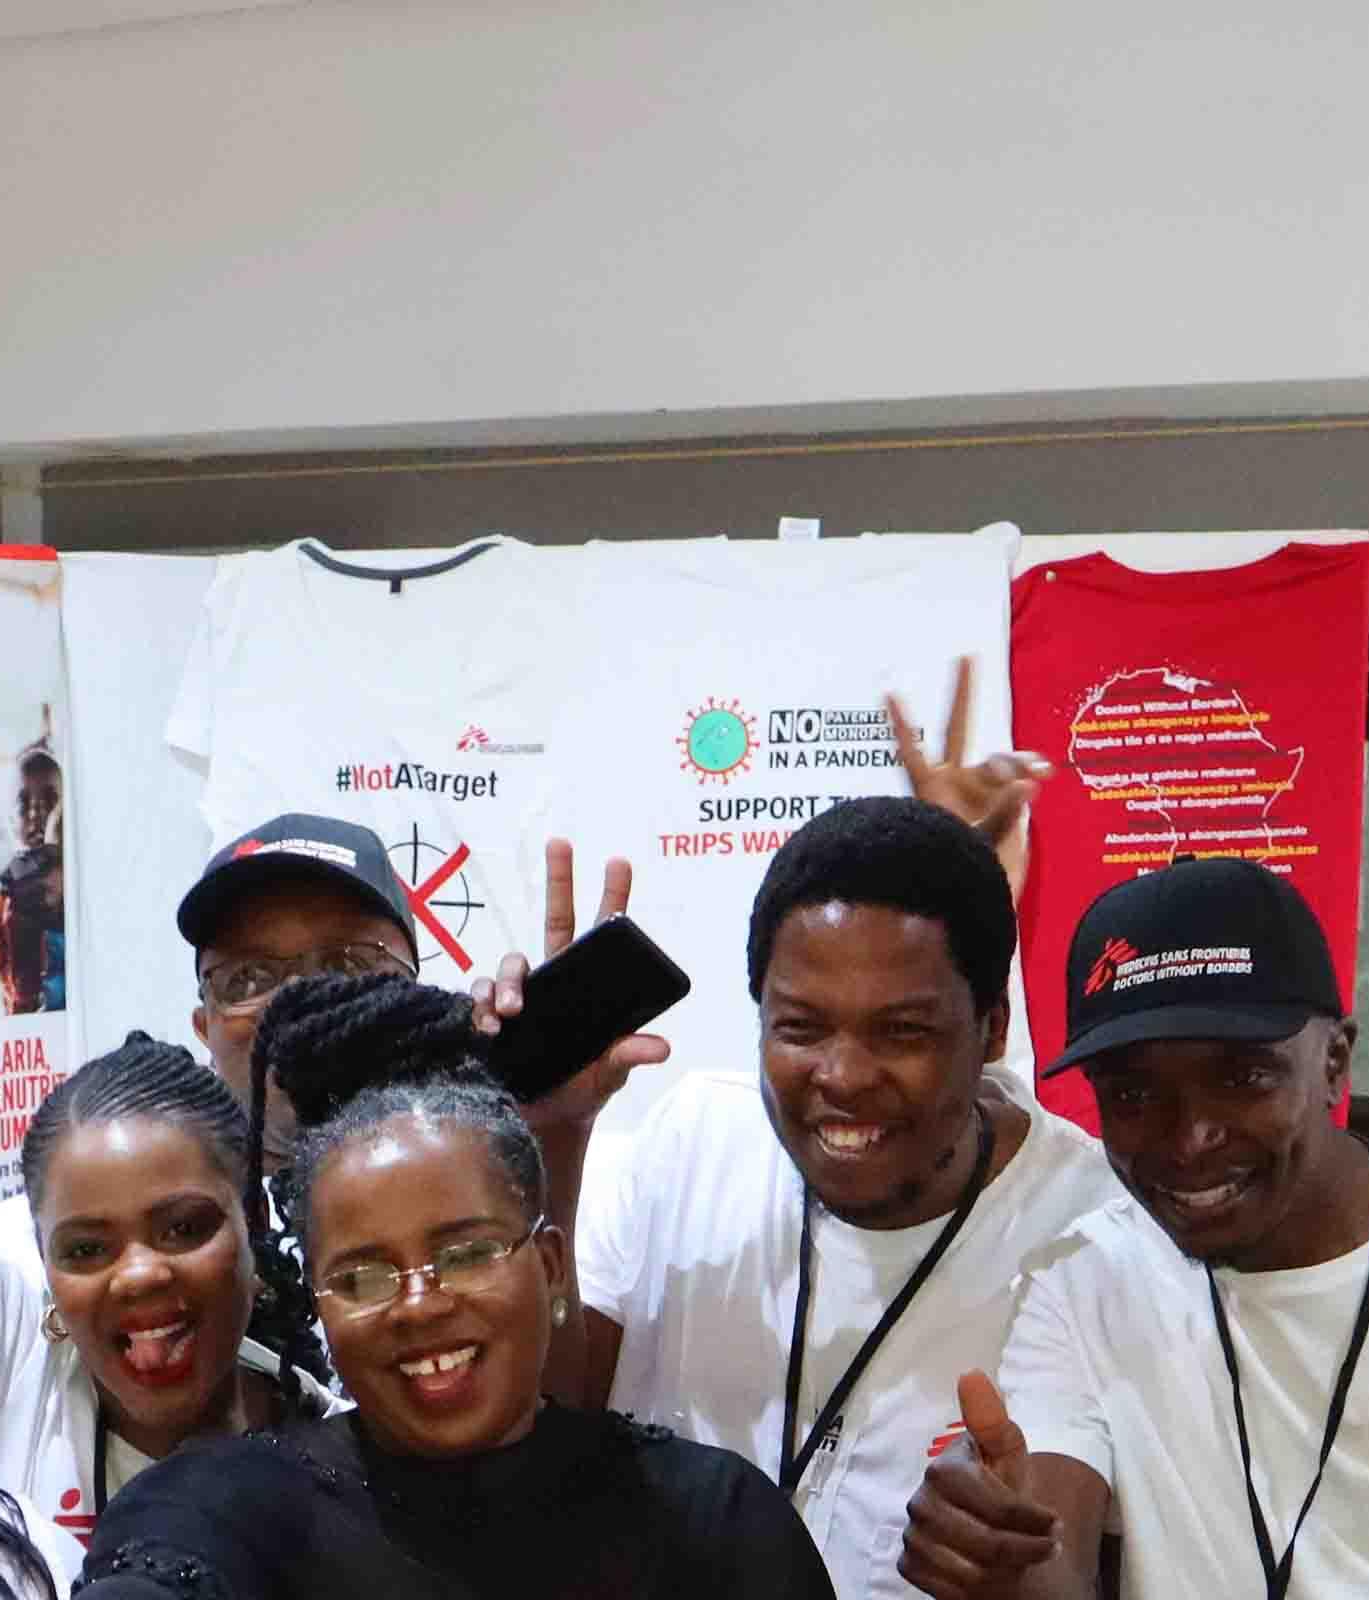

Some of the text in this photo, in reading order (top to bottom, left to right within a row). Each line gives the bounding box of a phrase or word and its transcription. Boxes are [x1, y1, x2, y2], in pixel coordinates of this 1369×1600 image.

[768, 709, 822, 743] NO
[824, 726, 923, 742] MONOPOLS
[769, 749, 904, 768] IN A PANDEM
[336, 762, 499, 801] #NotATarget
[698, 796, 820, 822] SUPPORT
[659, 831, 734, 857] TRIPS
[1161, 949, 1189, 964] SANS
[1113, 970, 1156, 992] DOCTORS
[1157, 963, 1205, 980] WITHOUT
